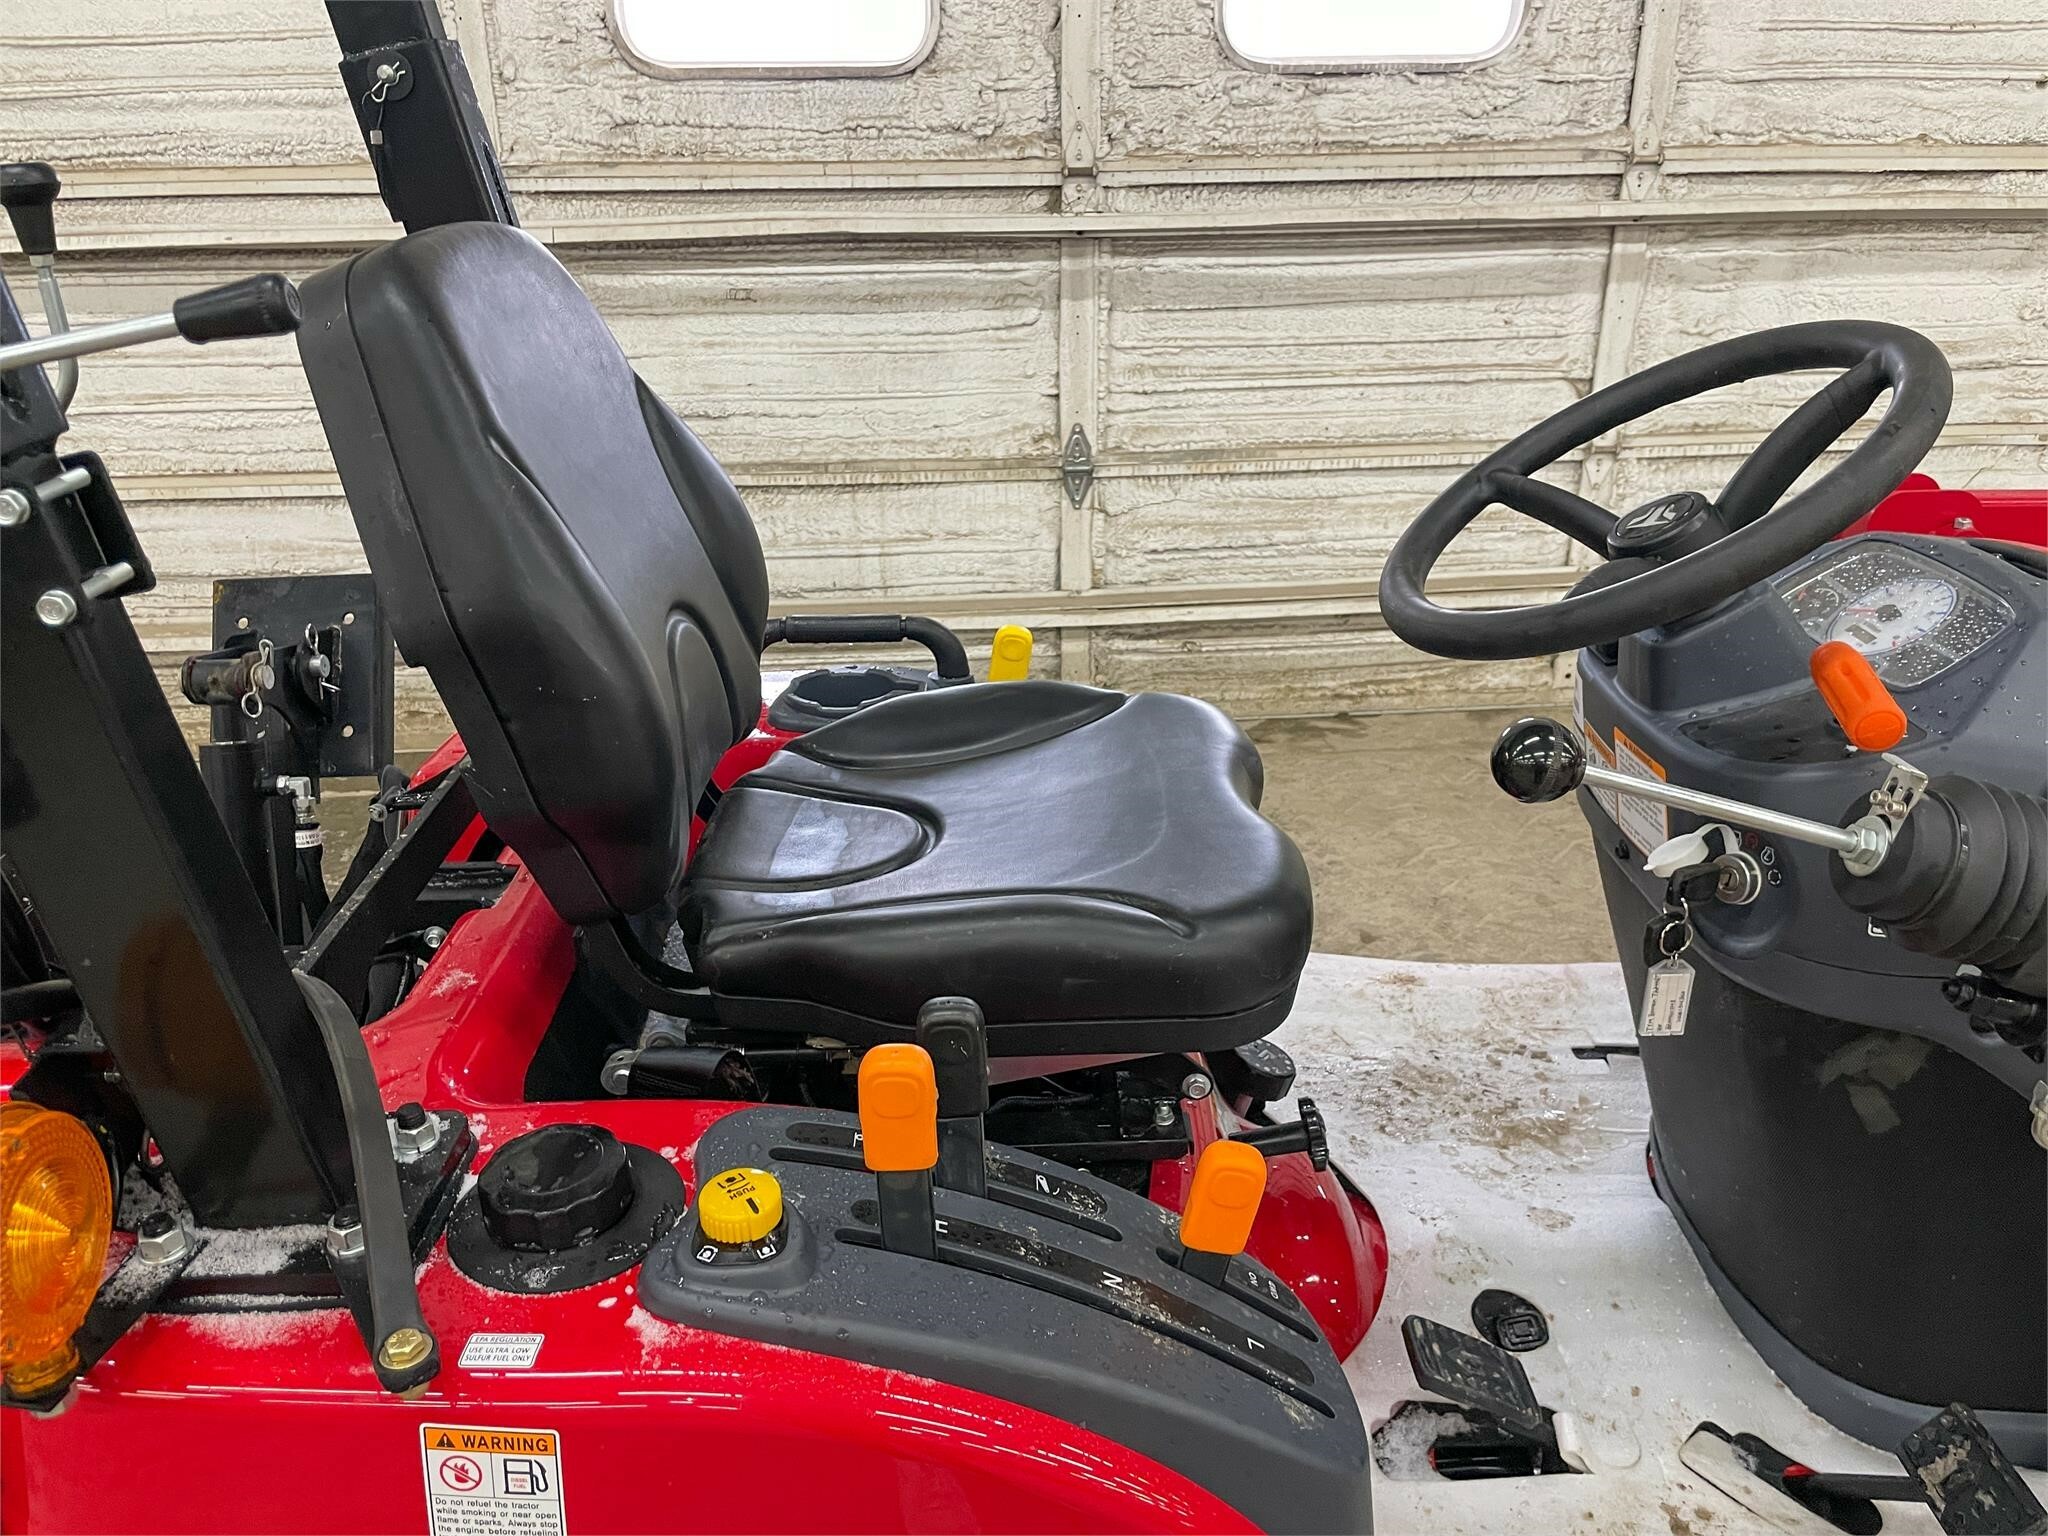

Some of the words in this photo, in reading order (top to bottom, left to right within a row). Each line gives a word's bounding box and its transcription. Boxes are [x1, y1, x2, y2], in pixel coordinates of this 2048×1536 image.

[728, 1186, 756, 1200] PUSH
[1102, 1271, 1124, 1291] N
[462, 1434, 548, 1452] WARNING
[435, 1497, 446, 1505] Do
[467, 1499, 491, 1507] refuel
[512, 1501, 539, 1509] tractor
[461, 1508, 496, 1518] smoking
[508, 1520, 536, 1528] Always
[540, 1520, 558, 1529] stop
[456, 1526, 485, 1535] engine
[489, 1526, 516, 1535] before
[520, 1528, 558, 1536] refueling
